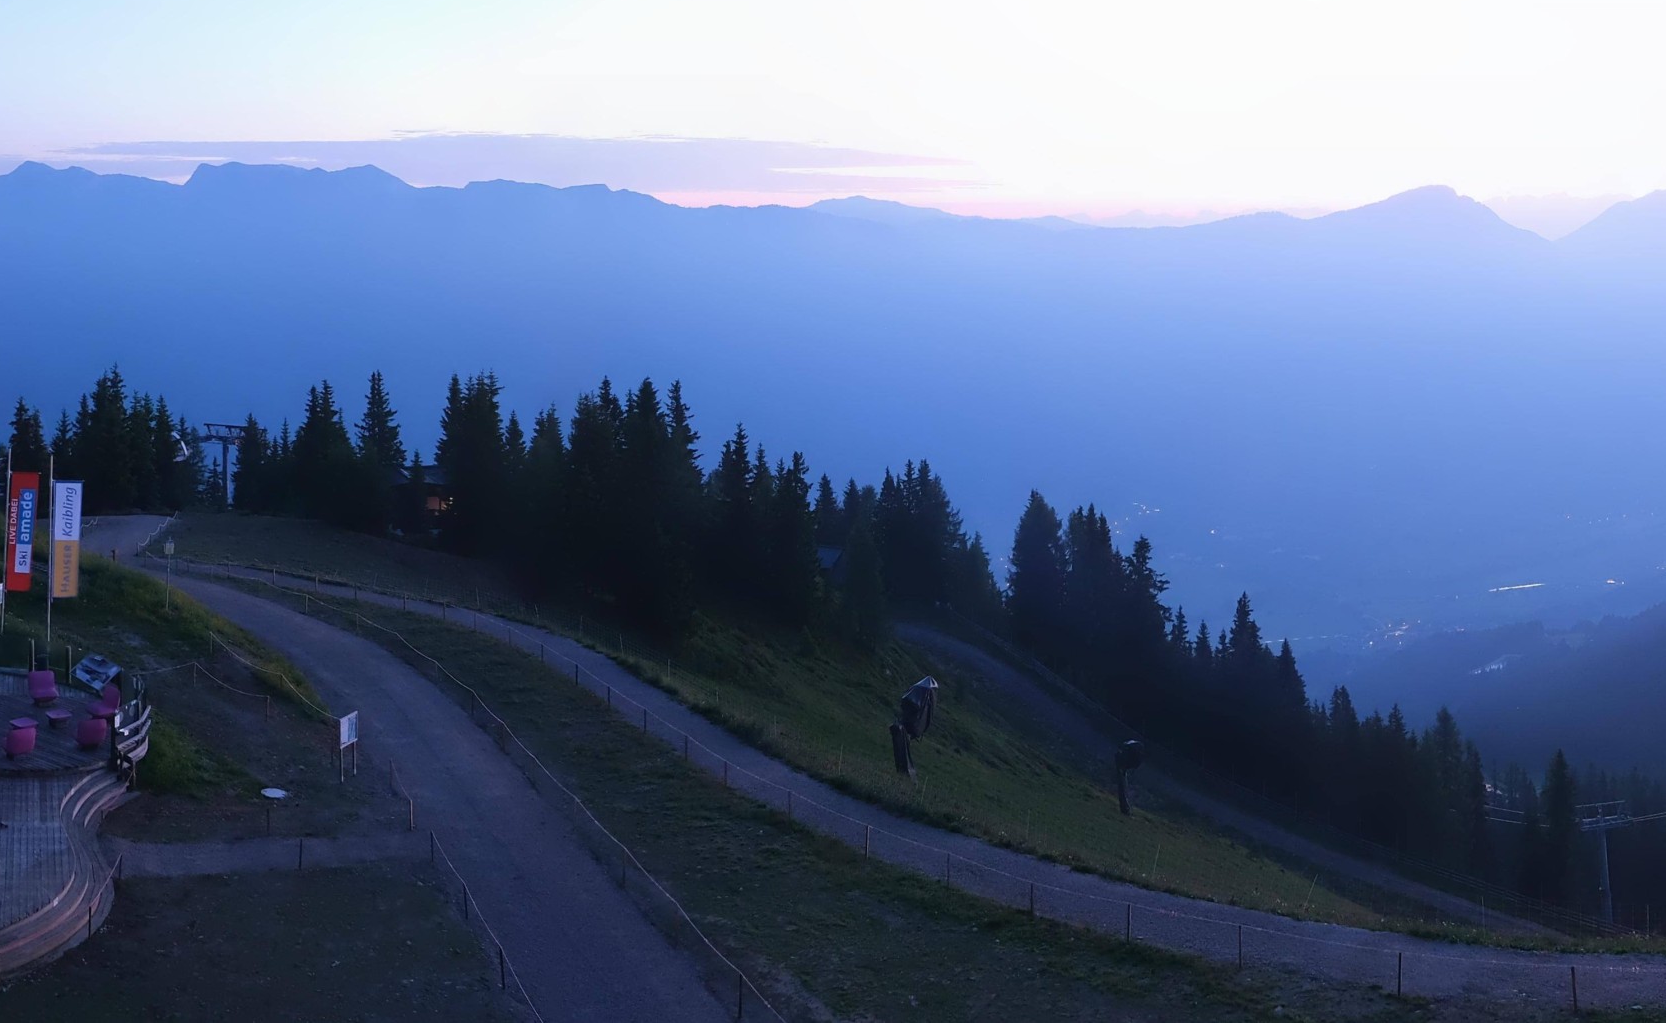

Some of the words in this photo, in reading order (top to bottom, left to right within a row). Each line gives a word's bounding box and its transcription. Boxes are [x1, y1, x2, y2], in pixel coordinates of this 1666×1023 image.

[10, 498, 18, 524] DABEI
[62, 486, 77, 537] Kaibling
[18, 550, 28, 567] Ski
